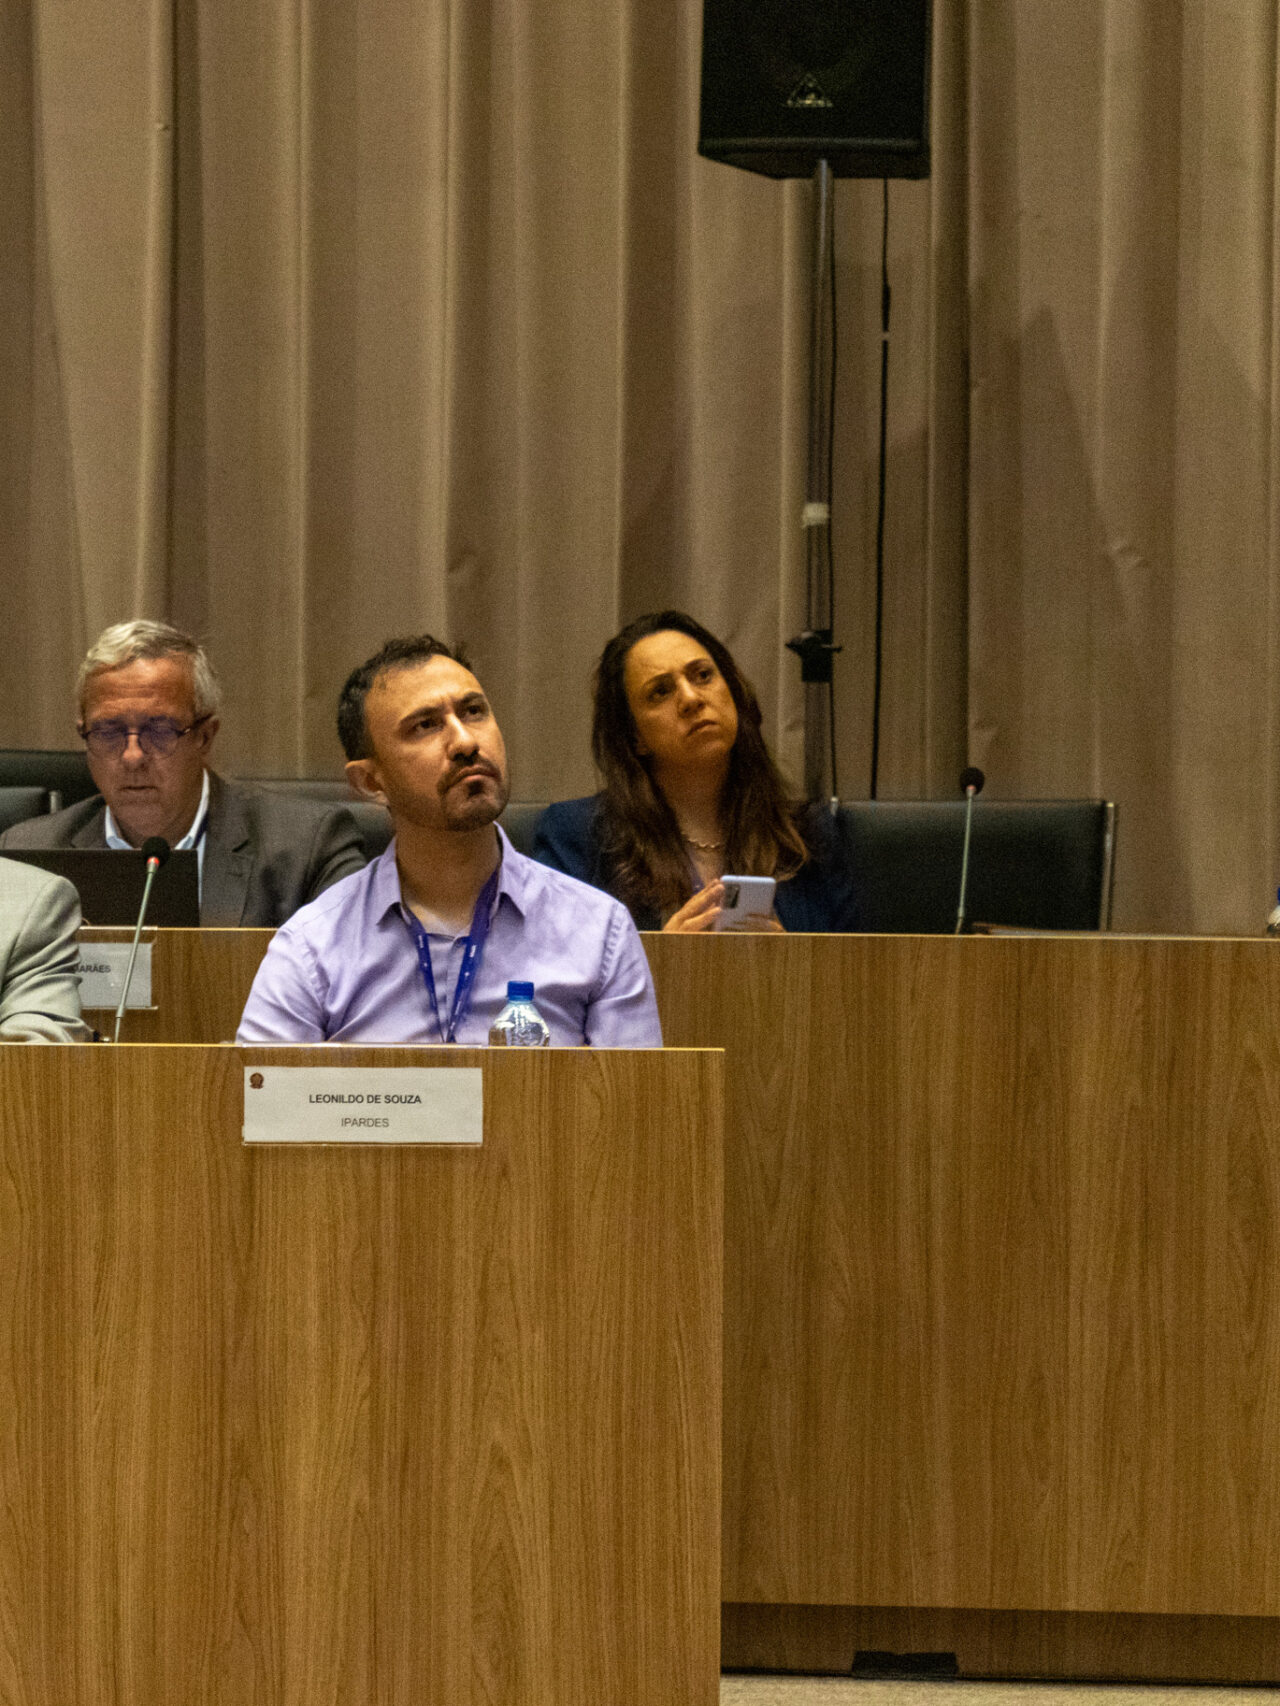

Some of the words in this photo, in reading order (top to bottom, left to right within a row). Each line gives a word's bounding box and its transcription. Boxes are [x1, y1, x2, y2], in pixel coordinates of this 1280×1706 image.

[308, 1093, 365, 1104] LEONILDO
[366, 1094, 382, 1104] DE
[383, 1094, 422, 1105] SOUZA
[340, 1117, 390, 1128] IPARDES
